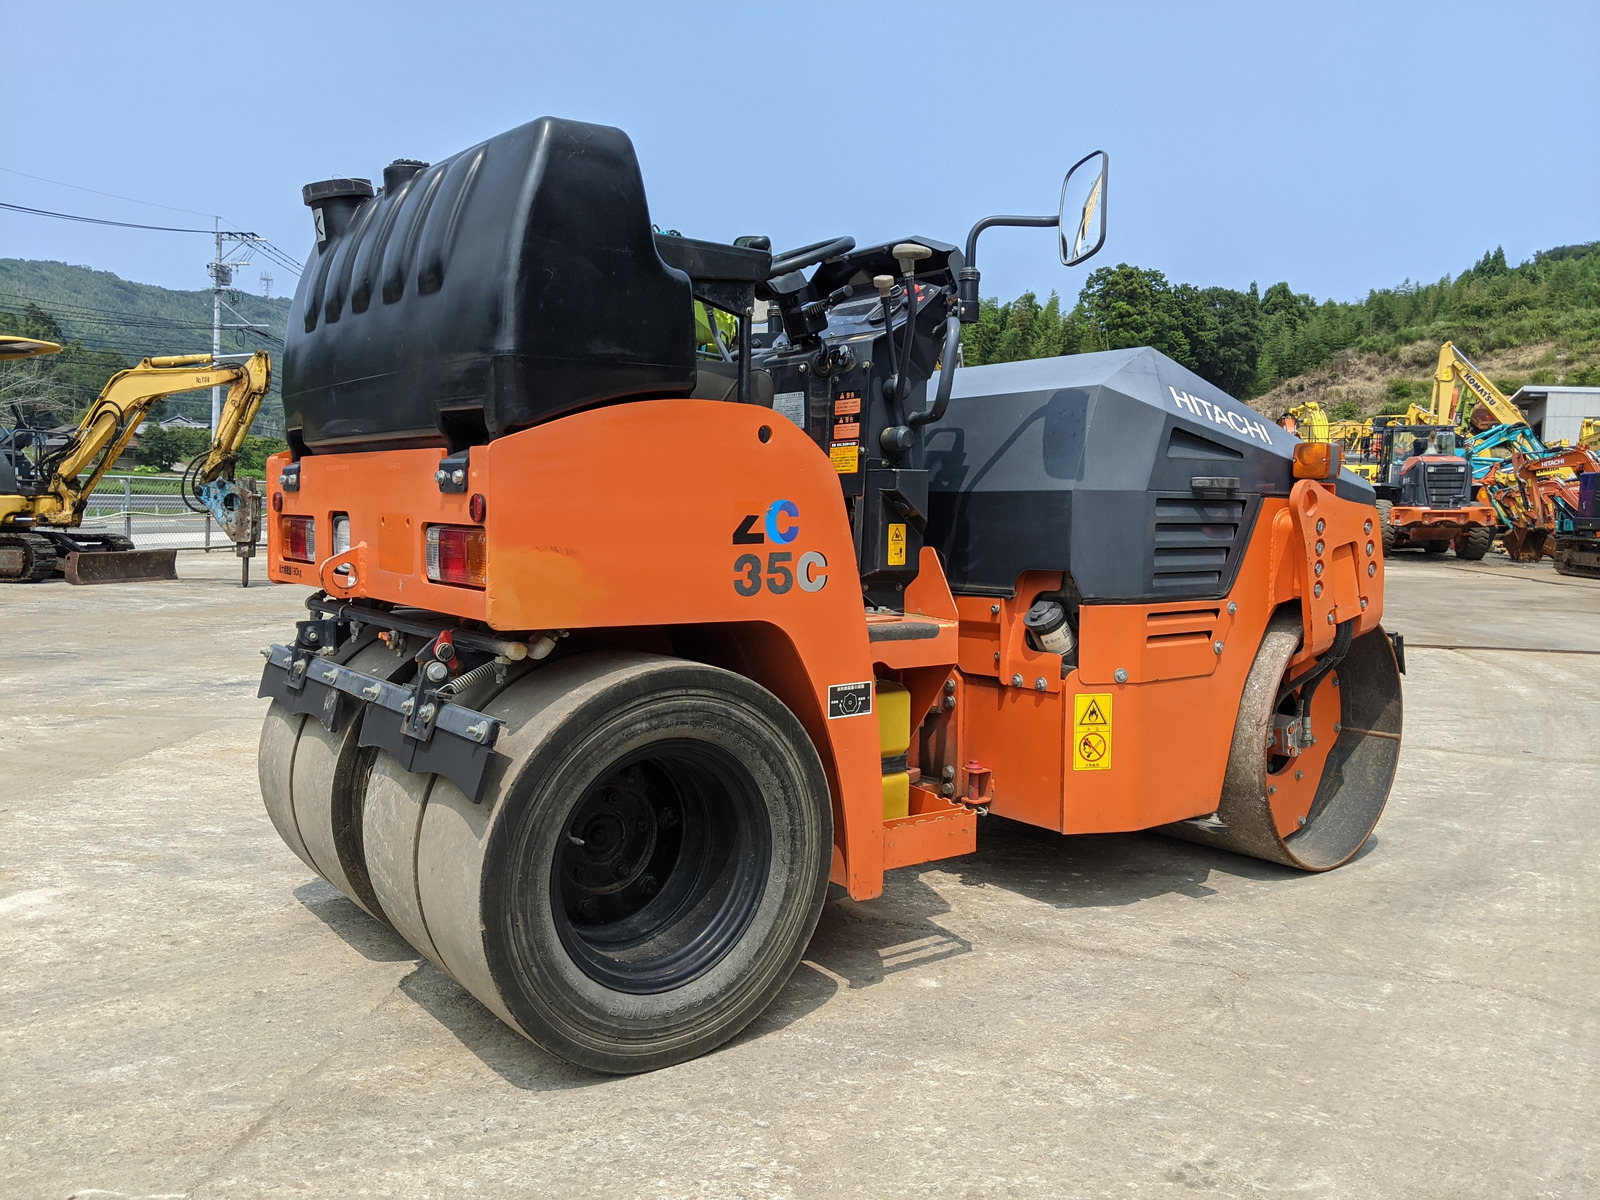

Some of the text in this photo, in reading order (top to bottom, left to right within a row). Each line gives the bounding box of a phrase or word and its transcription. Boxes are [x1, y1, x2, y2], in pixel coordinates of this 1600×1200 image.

[1463, 372, 1496, 406] KOMATSU
[1168, 385, 1273, 445] HITACHI
[1541, 458, 1565, 467] HITACHI
[733, 550, 828, 597] 35C
